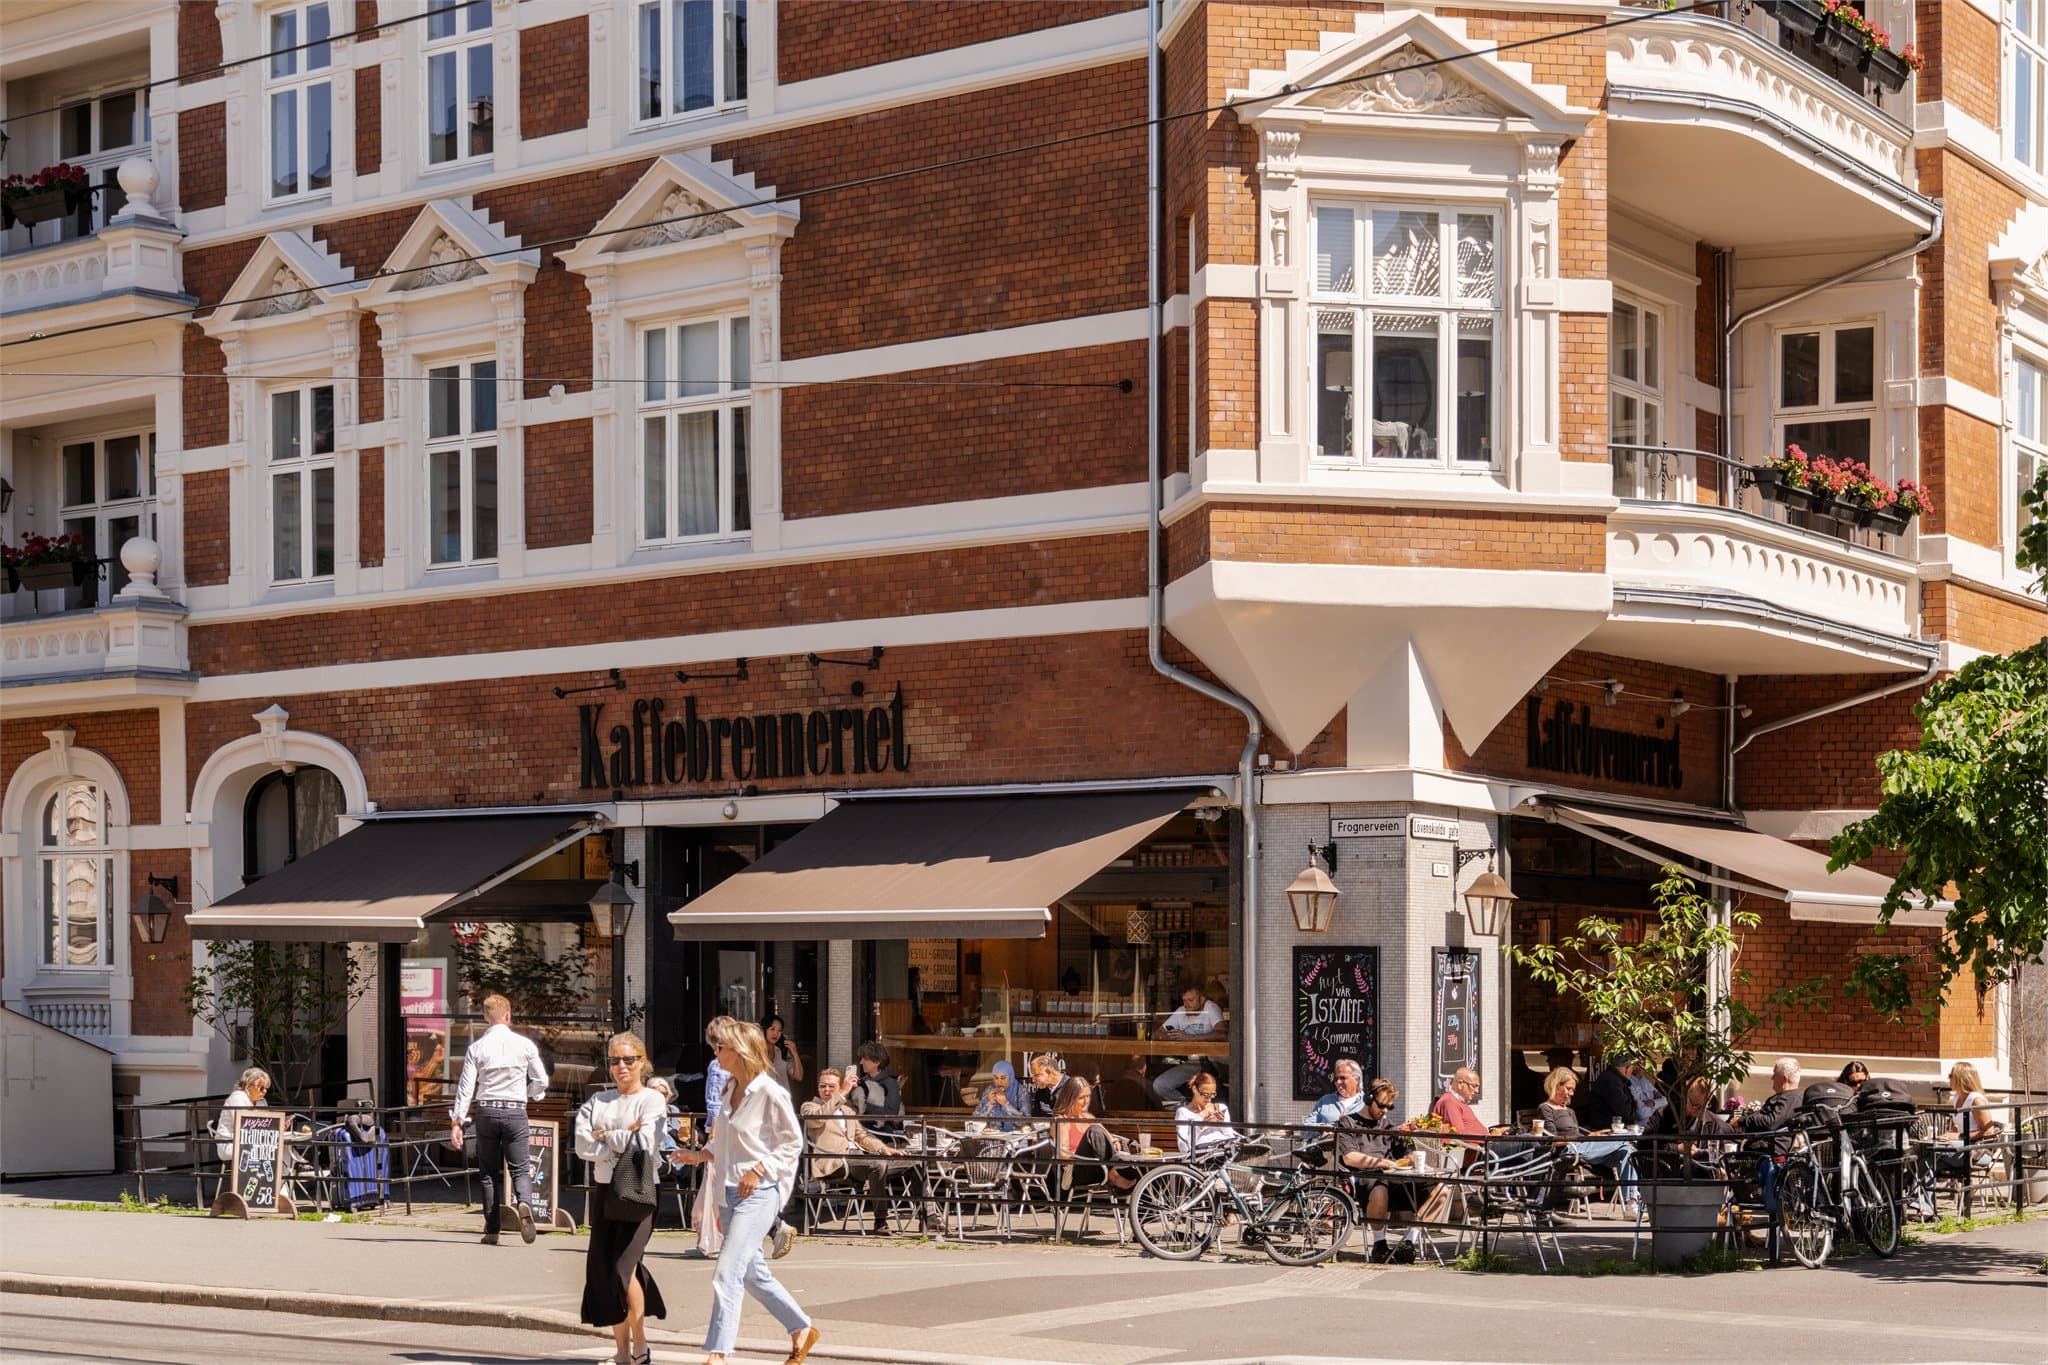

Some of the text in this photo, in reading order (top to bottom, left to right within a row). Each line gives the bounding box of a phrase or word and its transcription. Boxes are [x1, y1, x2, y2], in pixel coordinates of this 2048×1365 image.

[579, 680, 911, 790] Kaffebrenneriet
[1337, 821, 1400, 833] Frognerveien
[1335, 985, 1351, 998] VÅR
